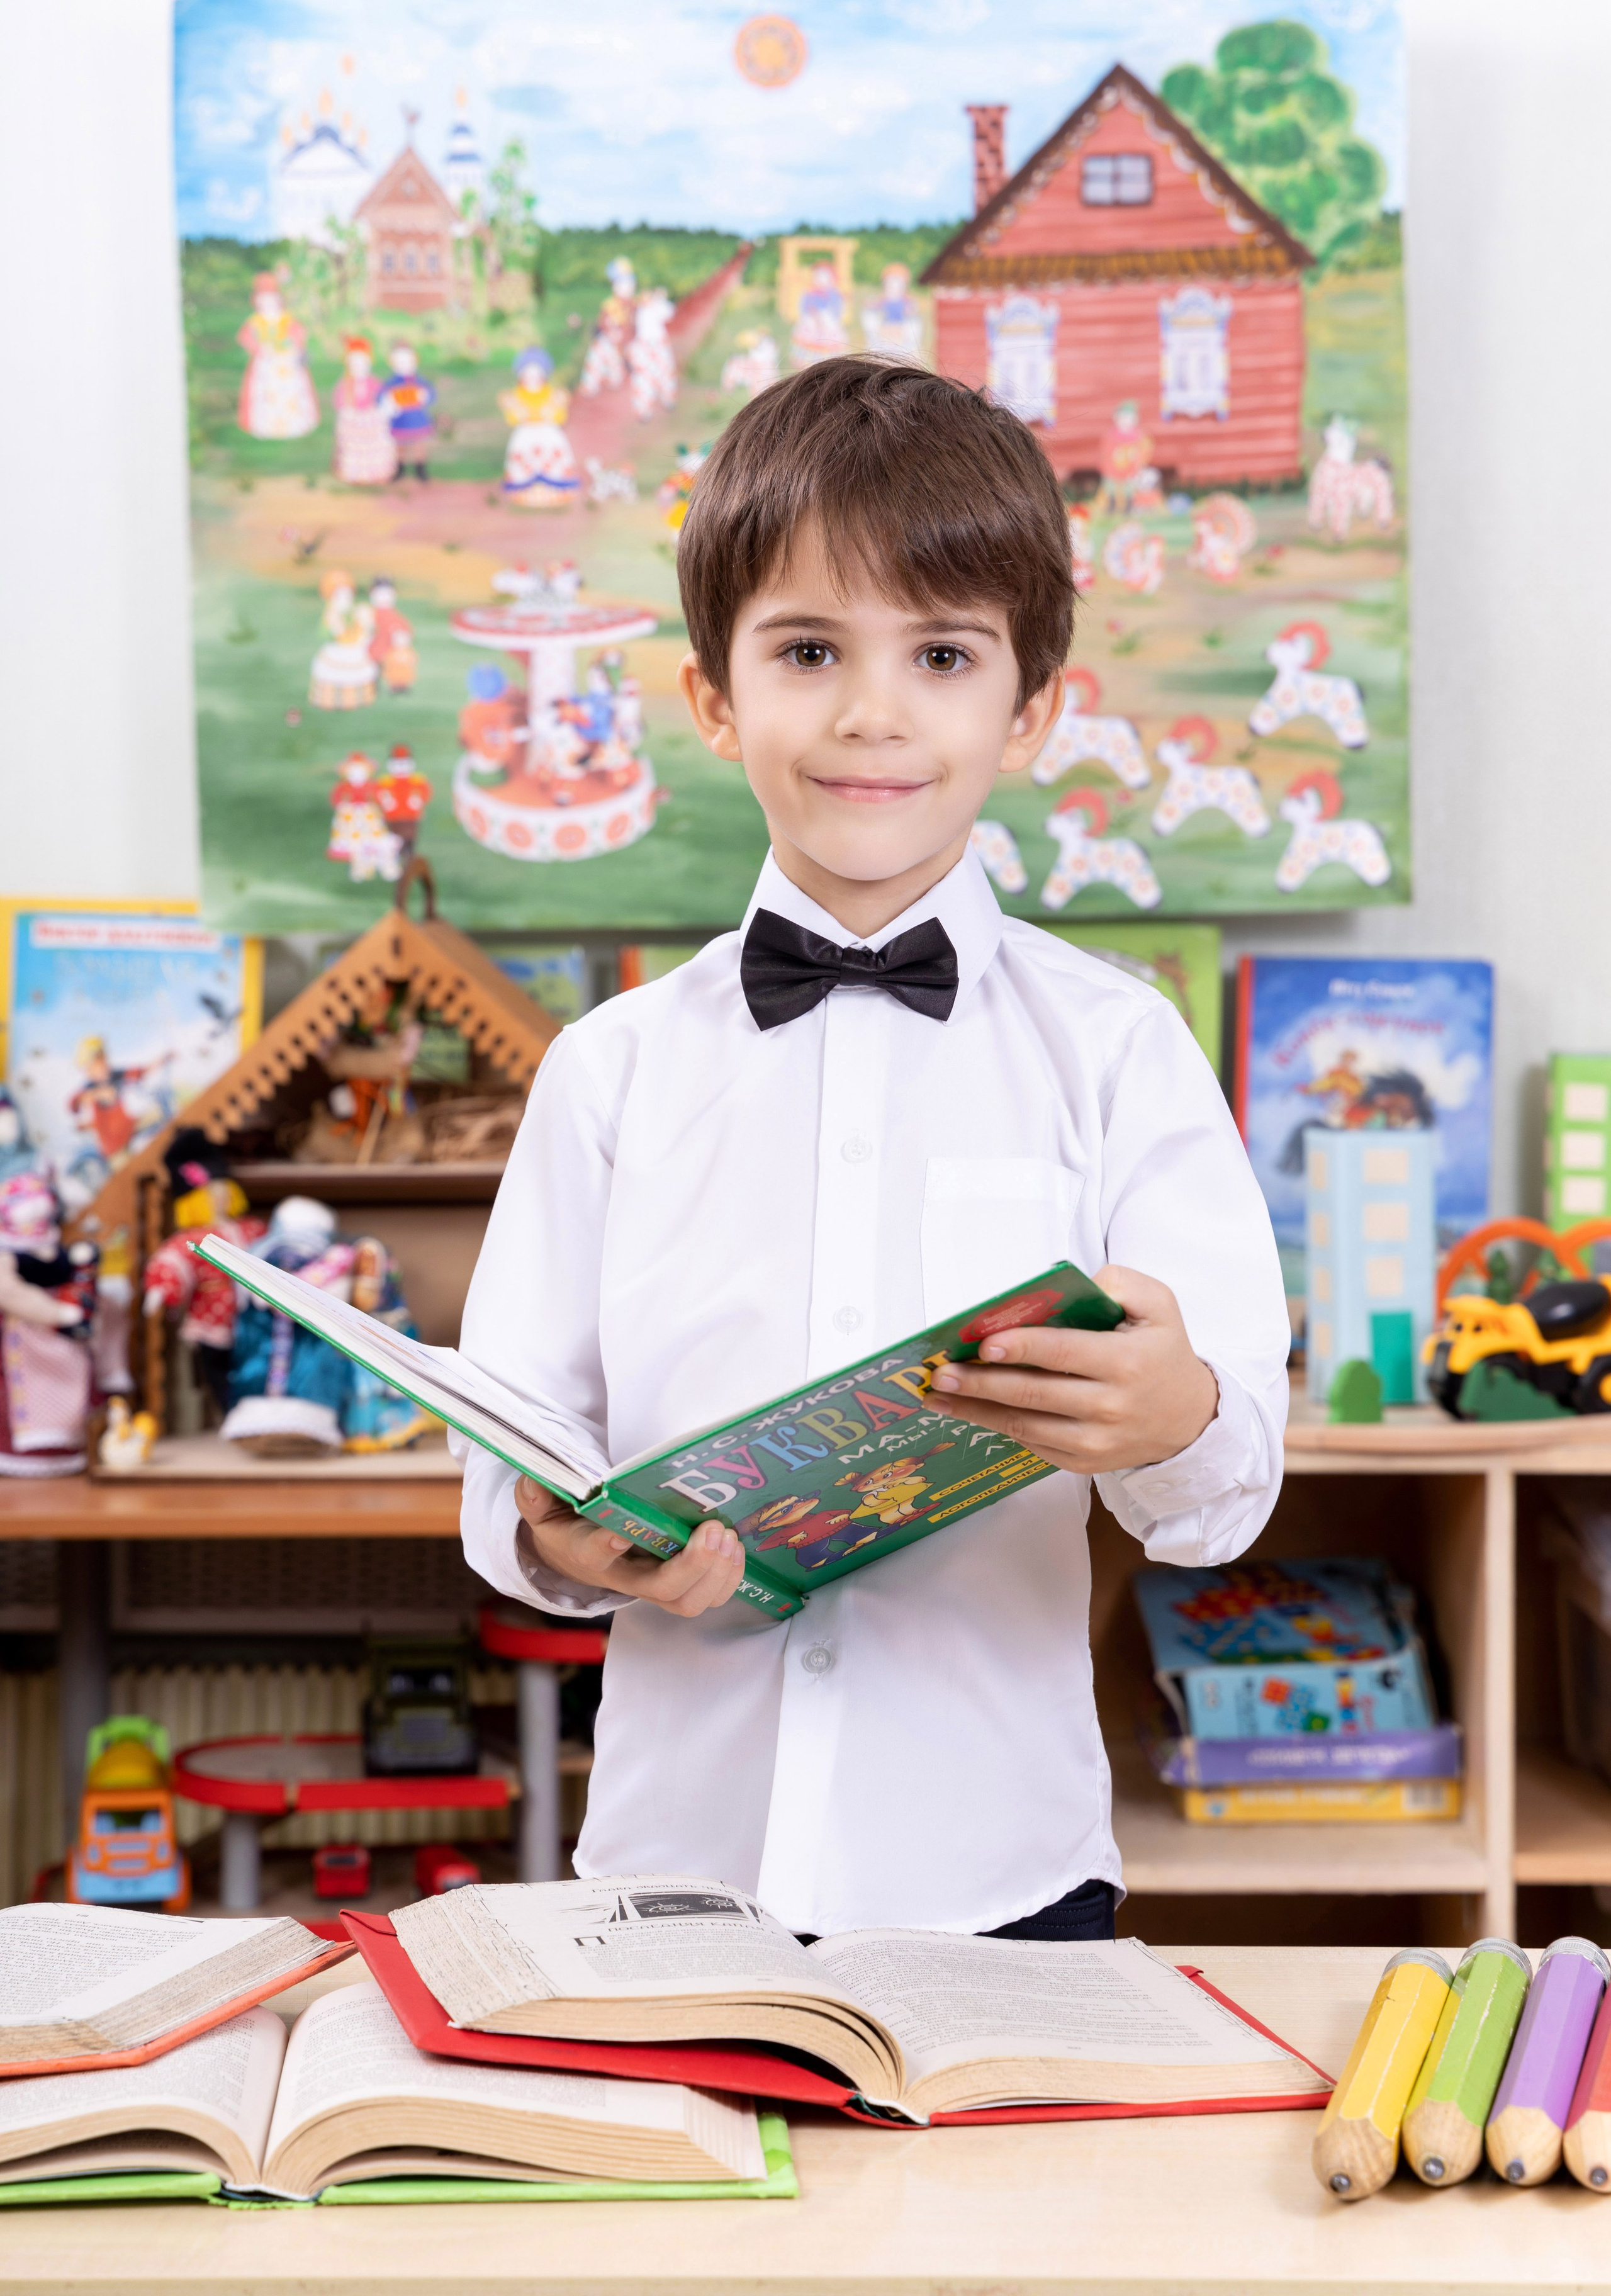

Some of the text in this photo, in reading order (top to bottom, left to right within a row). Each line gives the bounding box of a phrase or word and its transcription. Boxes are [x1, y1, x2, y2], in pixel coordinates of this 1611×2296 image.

[938, 1453, 1023, 1497] СОЧЕТАНИЕ
[939, 1461, 1051, 1519] ЛОГОПЕДИЧЕСК
[622, 1519, 680, 1556] КВАРЬ
[737, 1578, 775, 1604] Н.С.Ж
